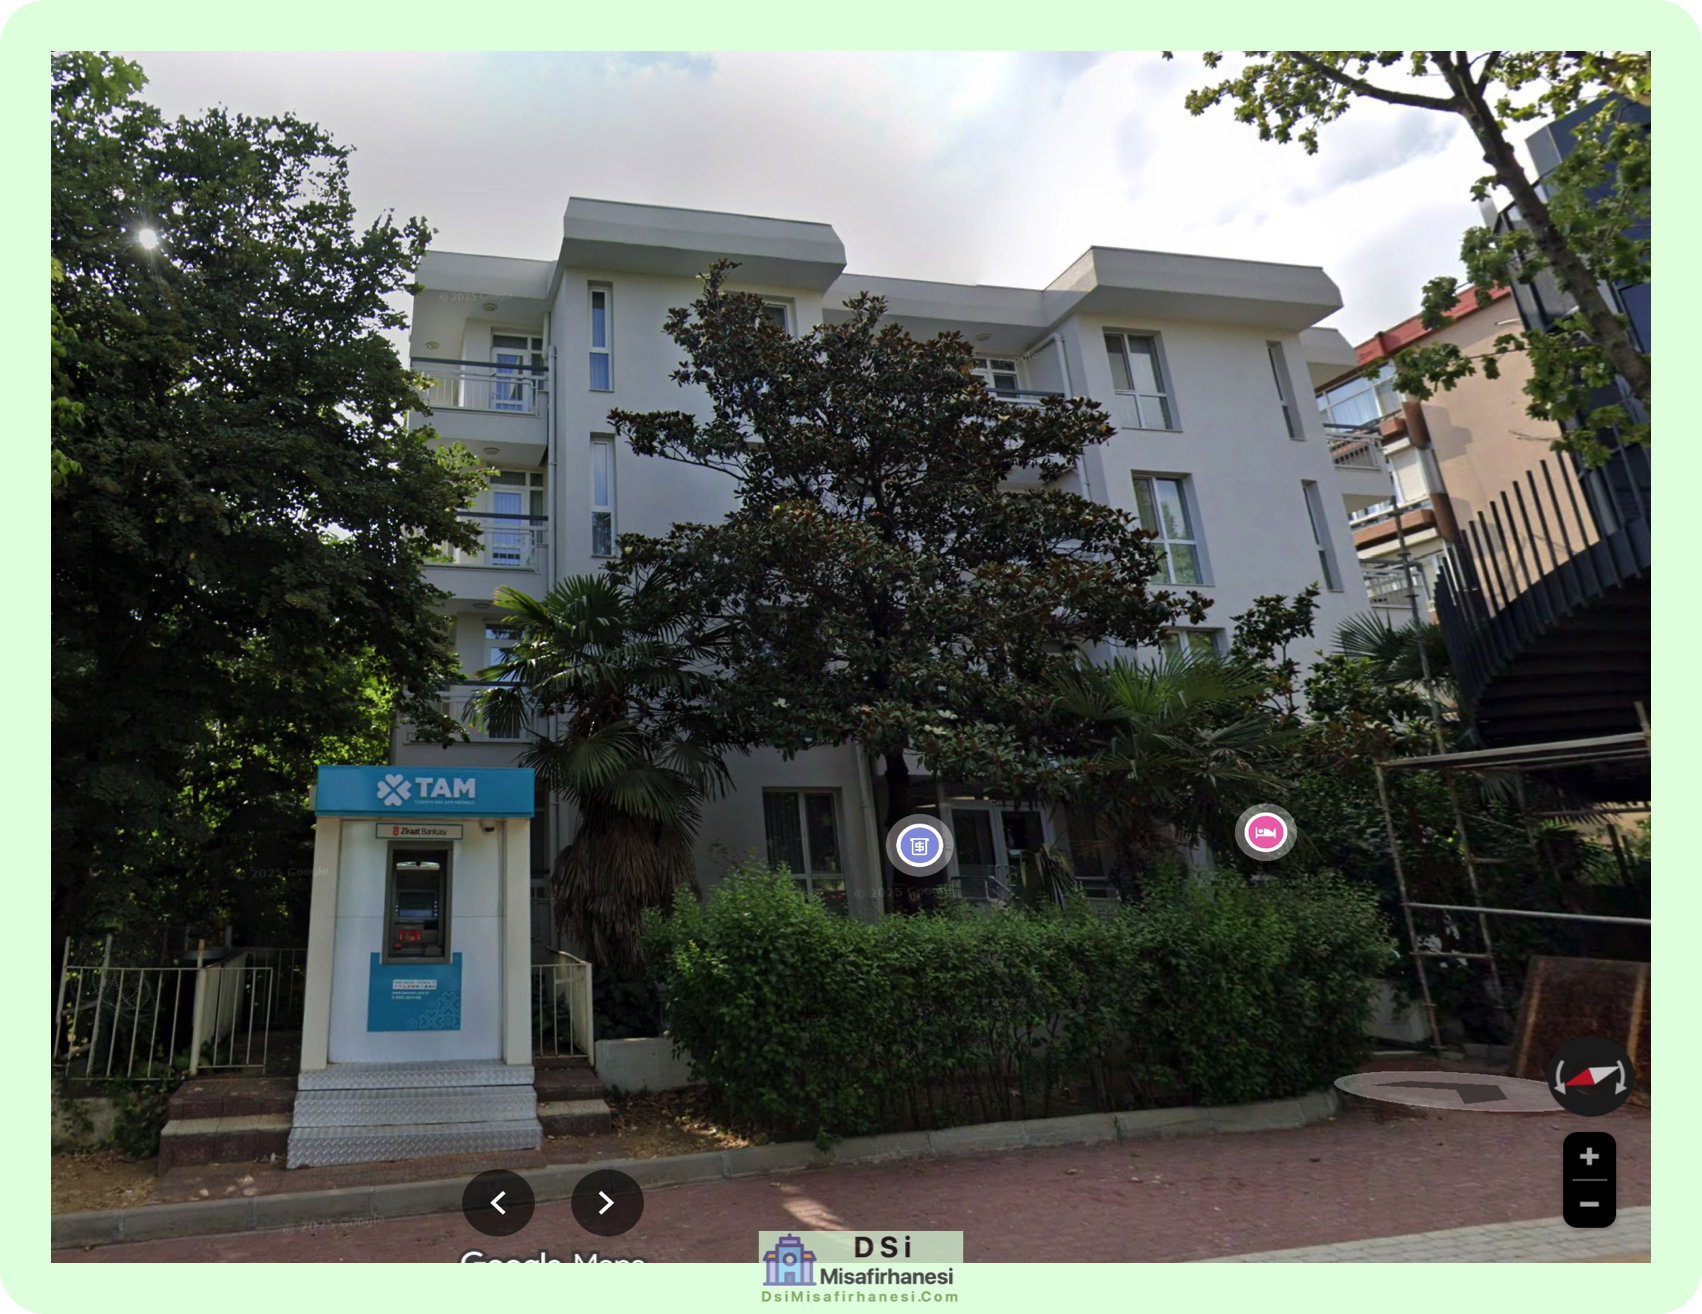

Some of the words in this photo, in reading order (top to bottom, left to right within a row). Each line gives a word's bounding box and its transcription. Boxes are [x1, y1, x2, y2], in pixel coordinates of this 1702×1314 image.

[415, 777, 476, 799] TAM
[401, 827, 420, 835] Ziraat
[421, 828, 447, 836] Bankası
